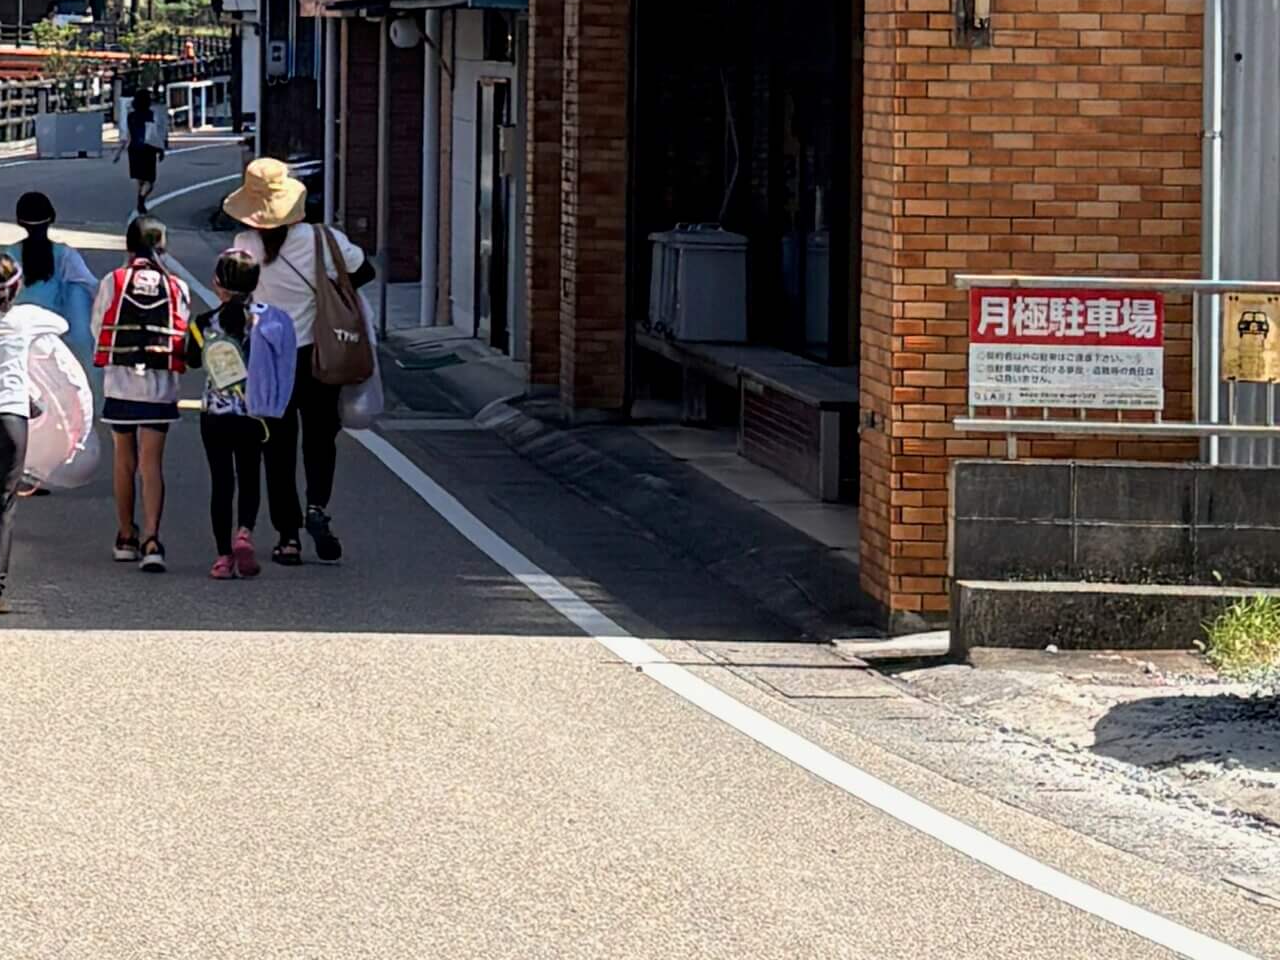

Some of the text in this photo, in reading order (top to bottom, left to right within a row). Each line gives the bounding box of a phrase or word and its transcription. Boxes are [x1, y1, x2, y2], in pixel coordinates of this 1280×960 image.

[977, 296, 1157, 339] 月極駐車場
